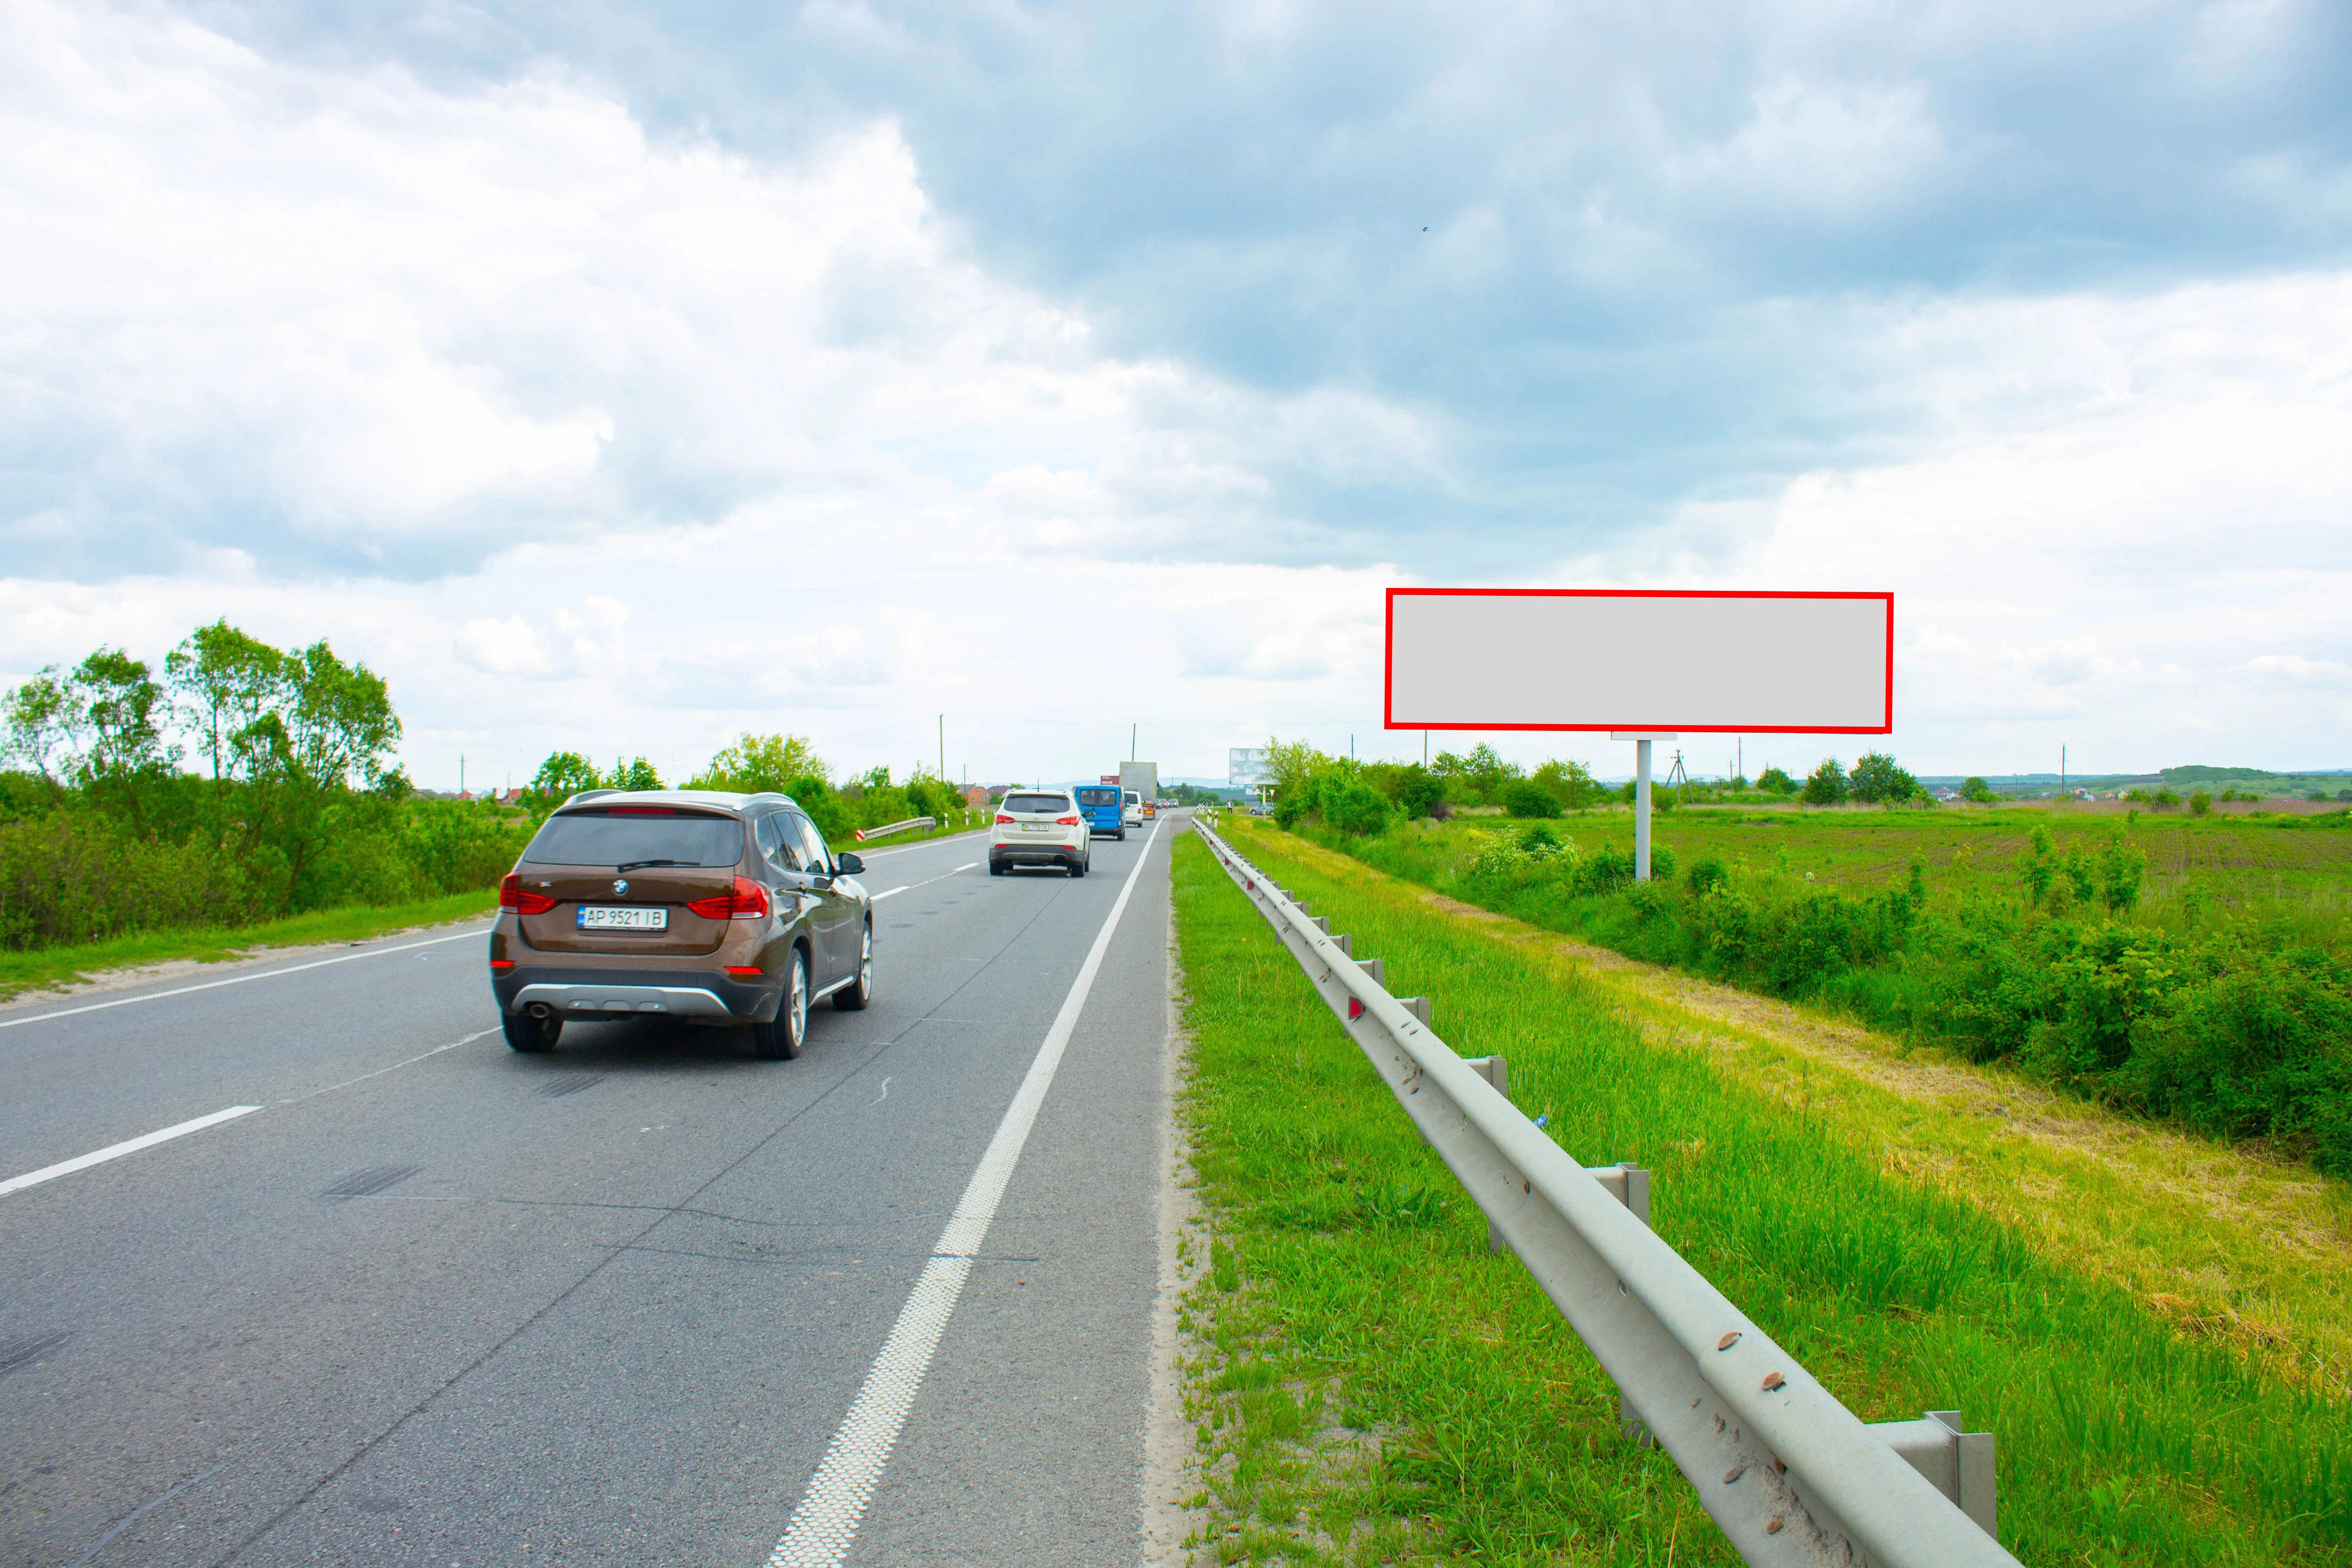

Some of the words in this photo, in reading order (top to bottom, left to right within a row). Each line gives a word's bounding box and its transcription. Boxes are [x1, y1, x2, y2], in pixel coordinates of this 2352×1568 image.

[586, 910, 606, 923] AP
[609, 911, 639, 925] 9521
[646, 911, 662, 925] IB
